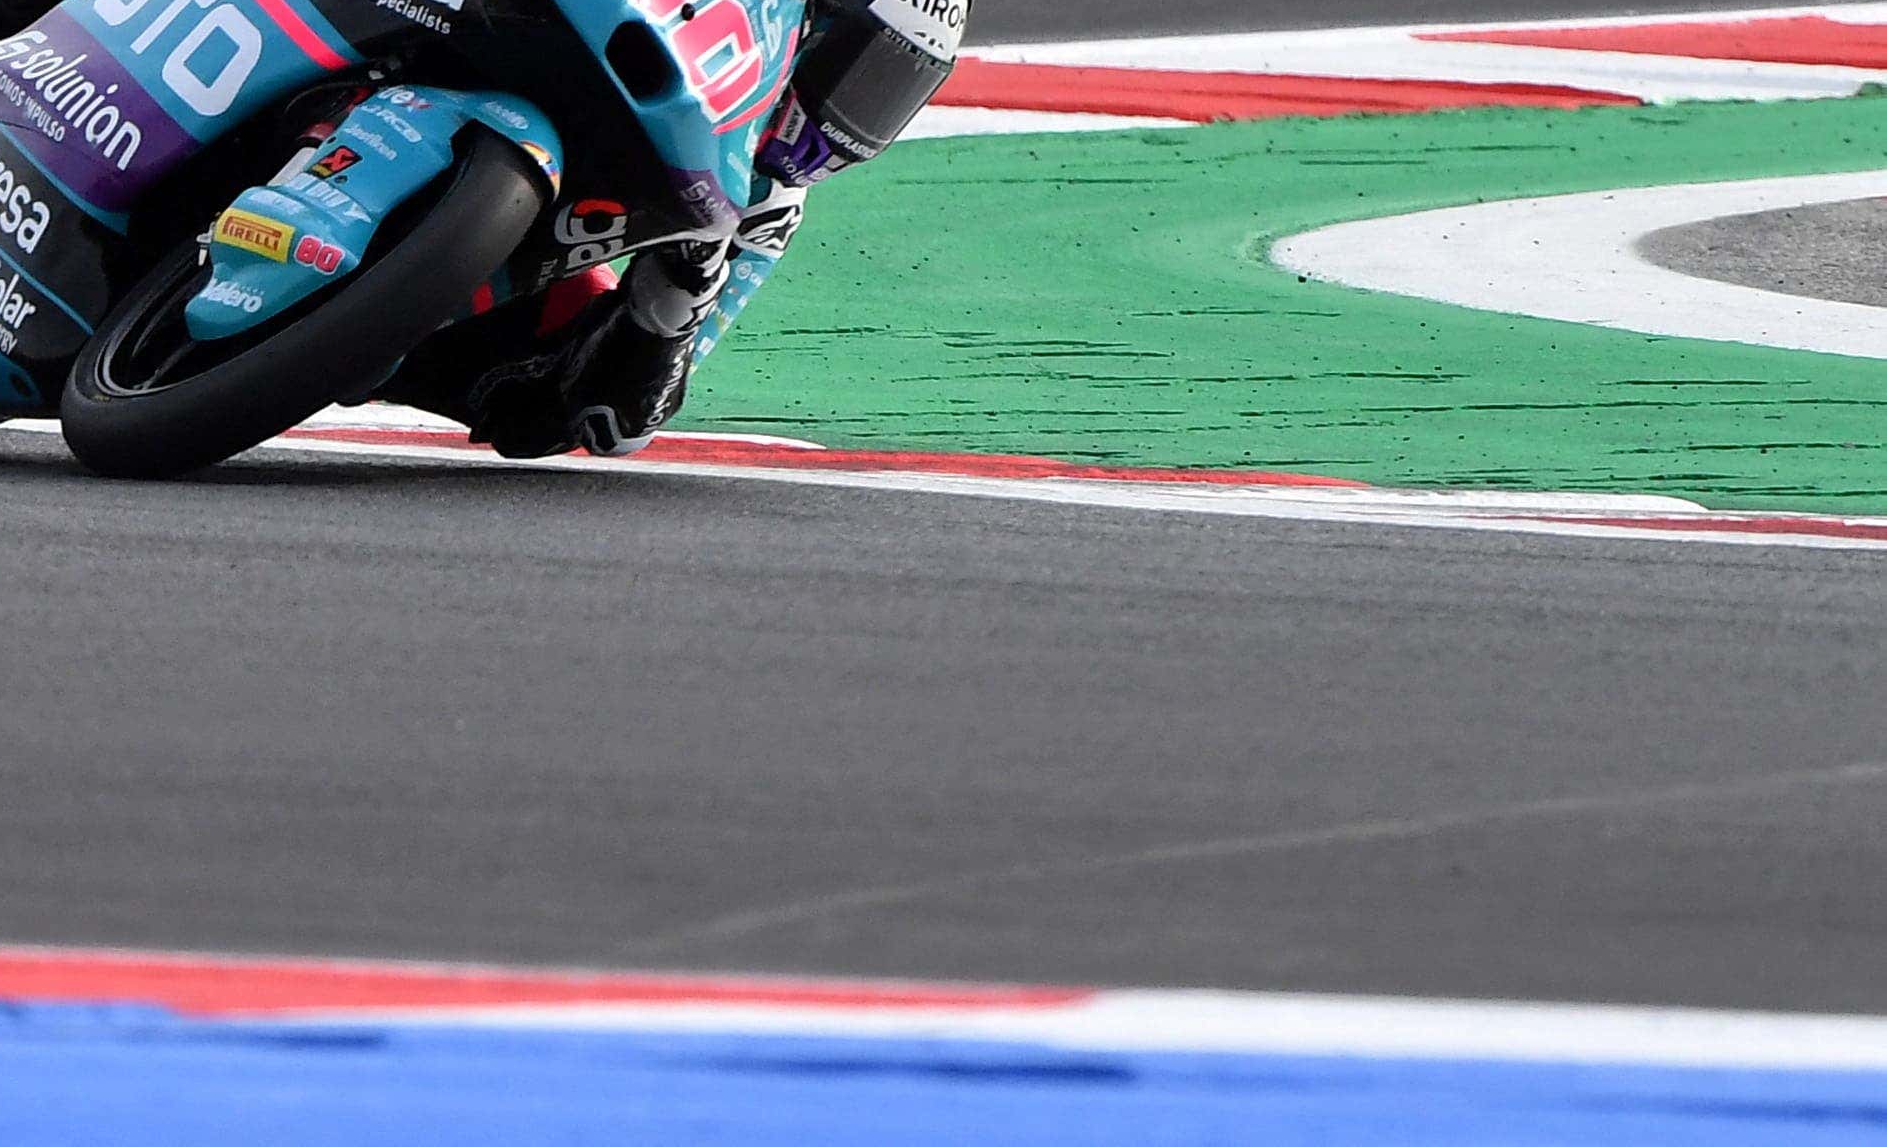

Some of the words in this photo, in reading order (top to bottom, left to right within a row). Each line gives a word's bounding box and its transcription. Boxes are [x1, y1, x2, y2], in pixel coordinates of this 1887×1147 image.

[10, 43, 143, 172] solunion
[222, 215, 282, 252] PIRELLI
[293, 235, 345, 275] 80
